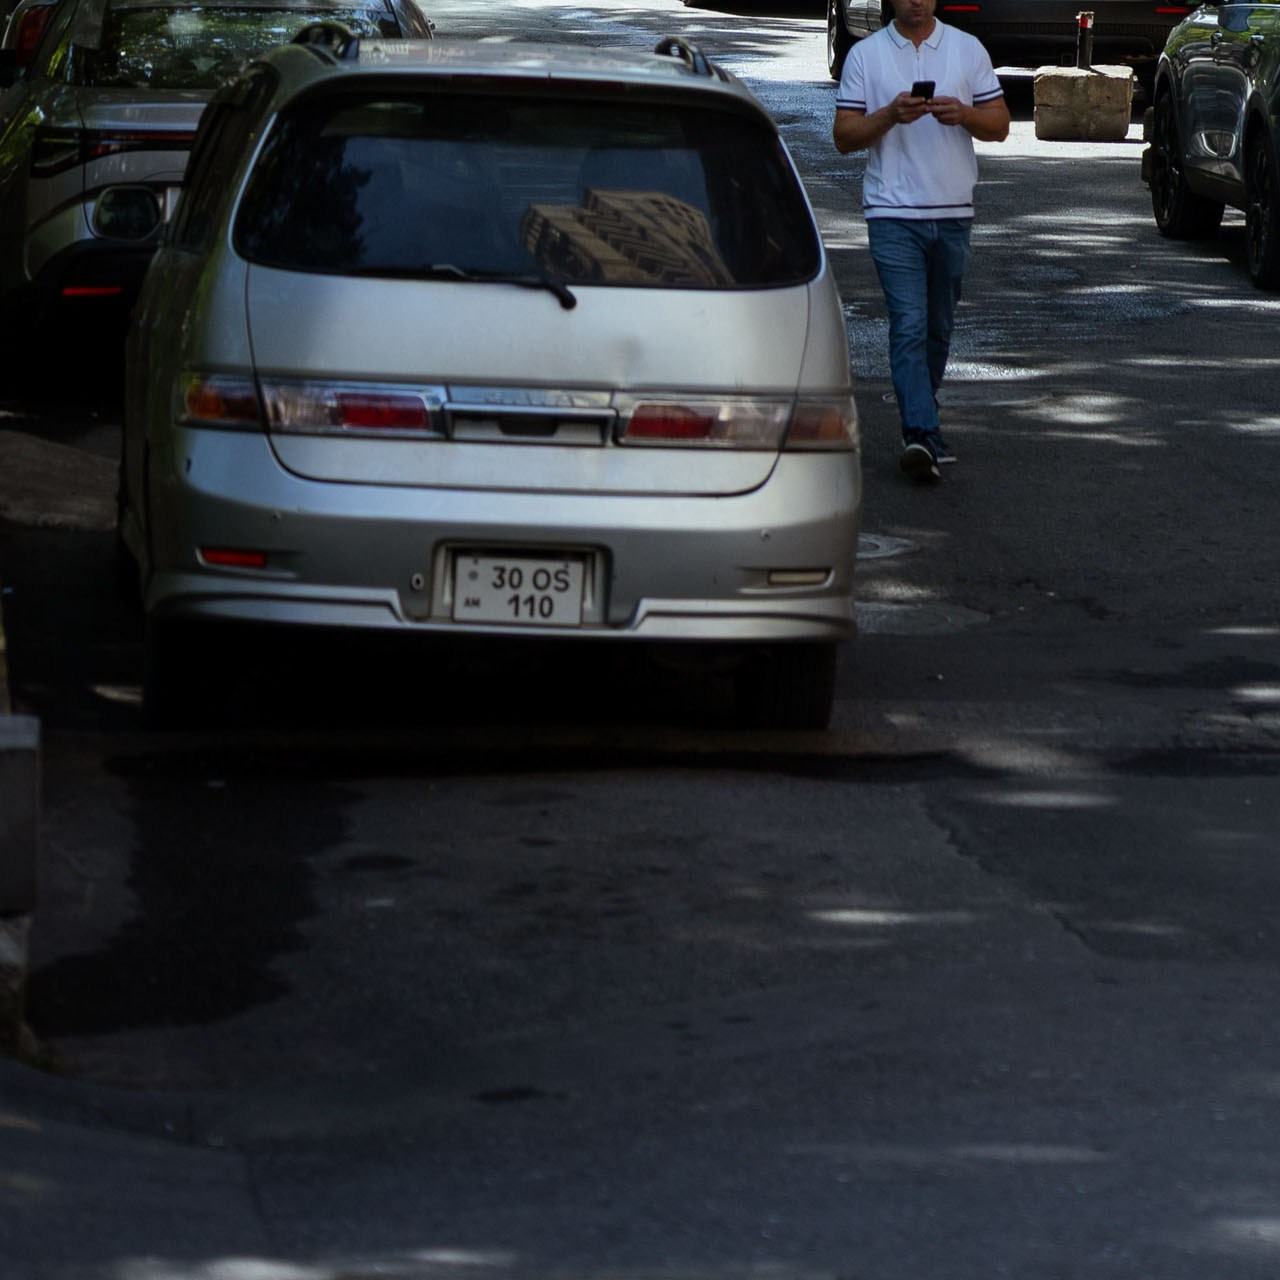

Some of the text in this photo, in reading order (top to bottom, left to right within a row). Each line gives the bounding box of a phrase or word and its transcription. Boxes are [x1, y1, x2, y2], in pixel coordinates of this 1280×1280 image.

[491, 565, 523, 590] 30
[463, 597, 481, 608] AM
[506, 594, 554, 618] 110
